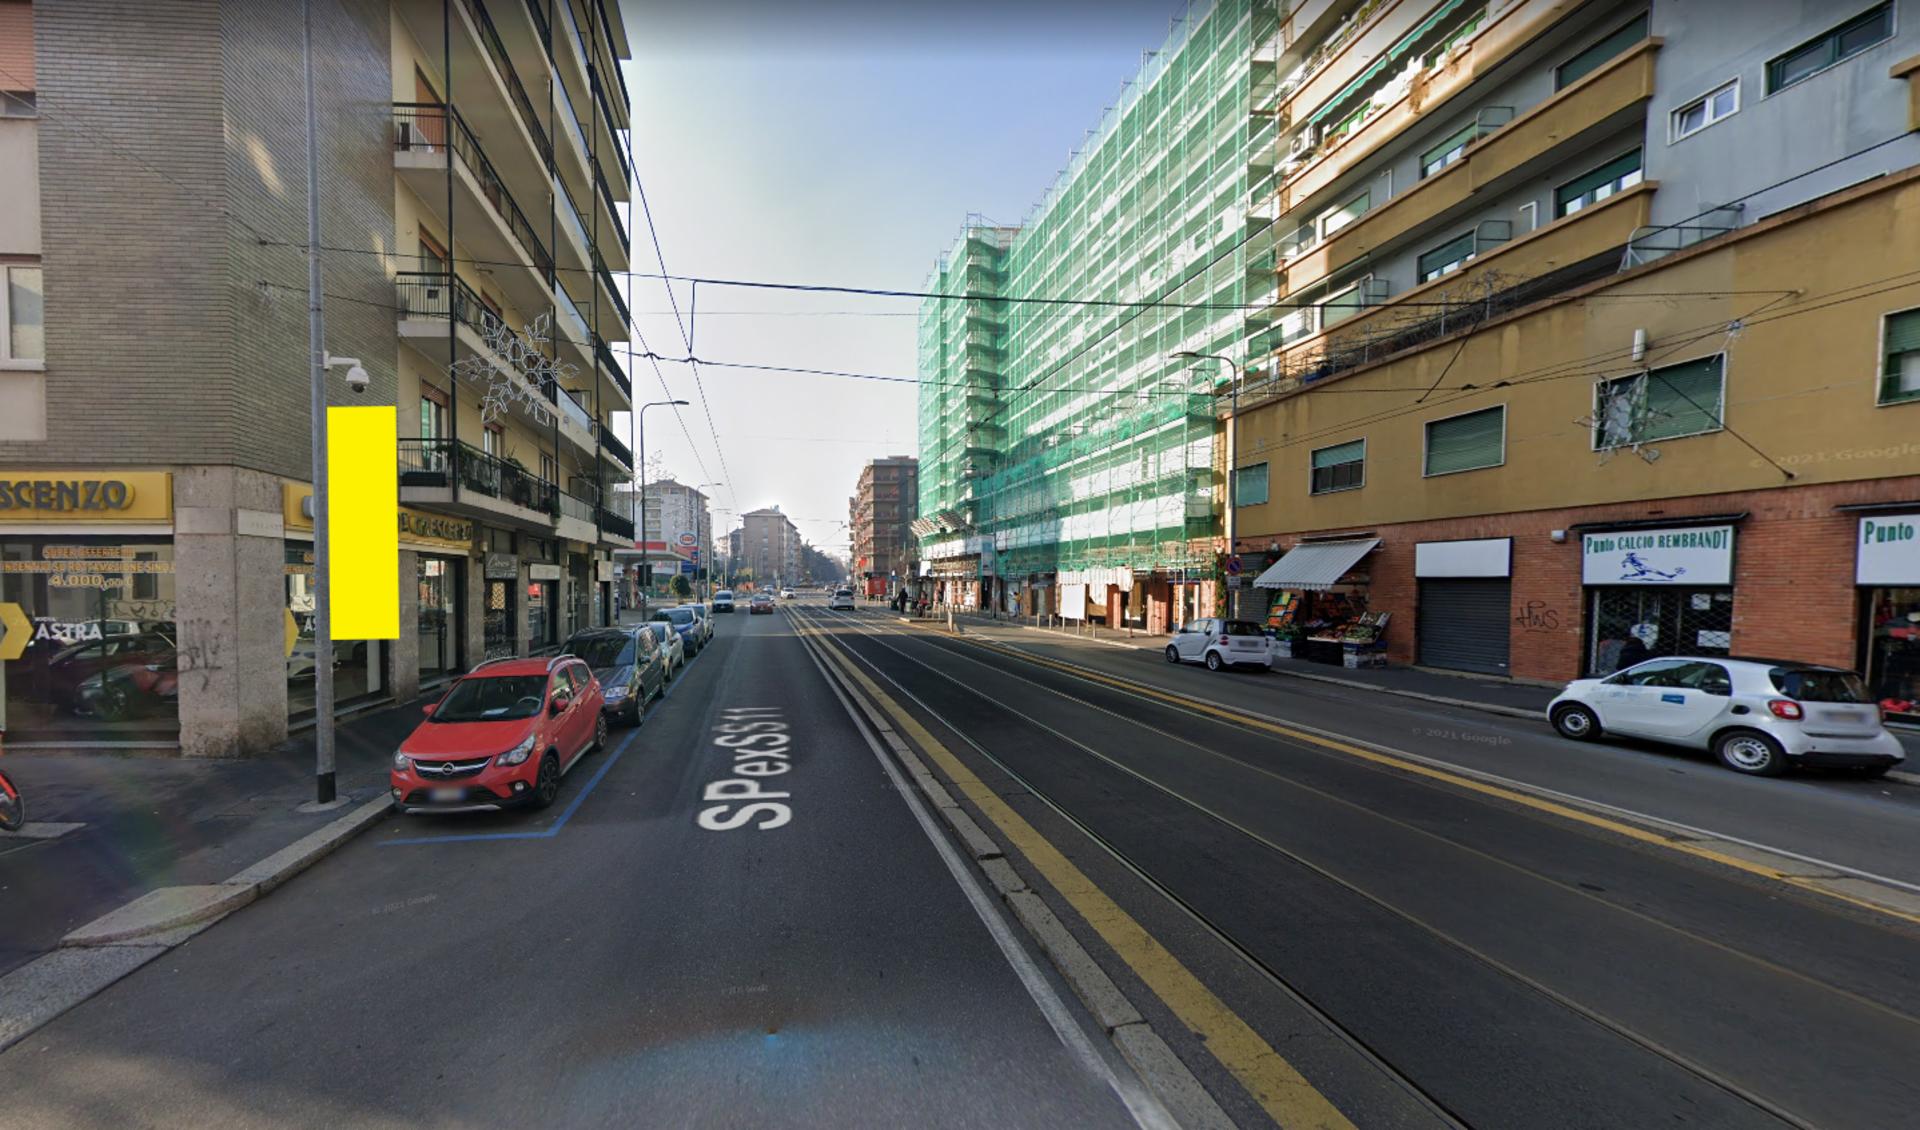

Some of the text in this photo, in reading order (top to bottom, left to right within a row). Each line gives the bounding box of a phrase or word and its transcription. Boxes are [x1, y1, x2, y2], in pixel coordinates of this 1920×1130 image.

[1586, 529, 1729, 554] Punto CALCIO REMBRANDT
[1863, 520, 1914, 545] Punto
[35, 622, 103, 641] ASTRA
